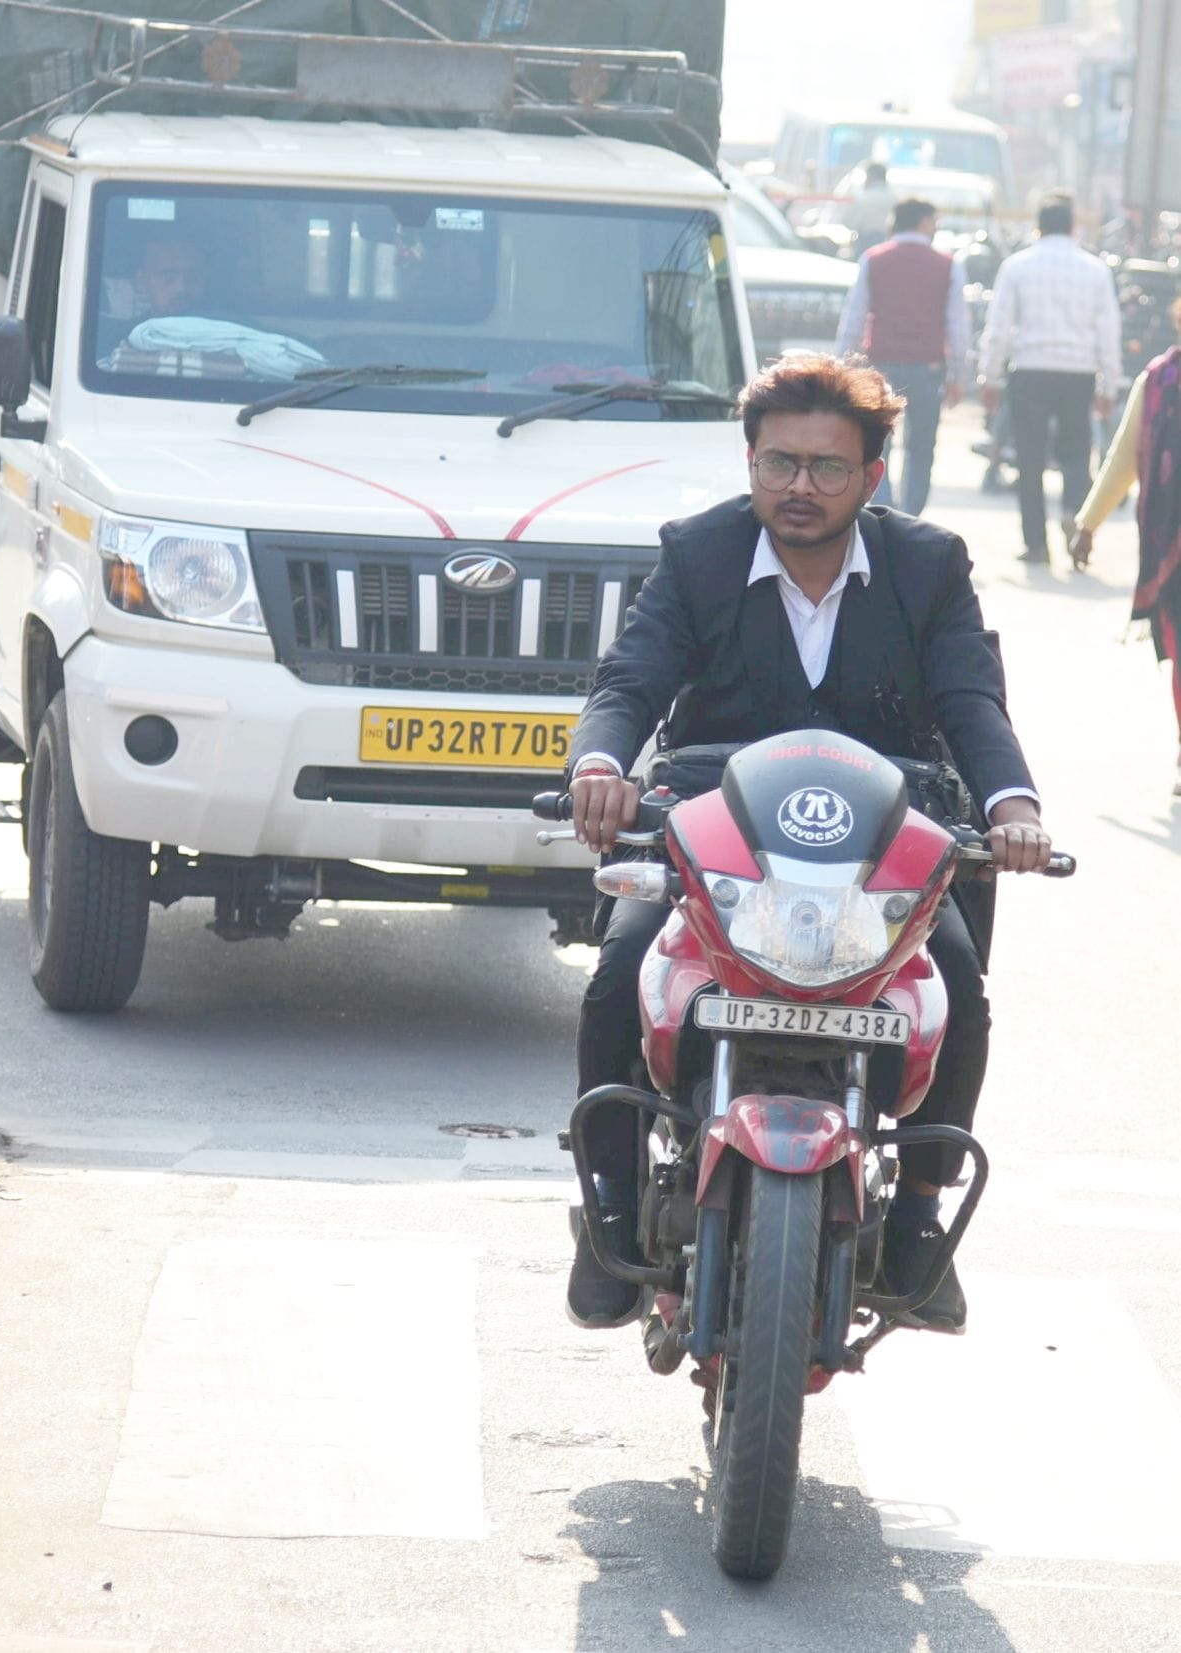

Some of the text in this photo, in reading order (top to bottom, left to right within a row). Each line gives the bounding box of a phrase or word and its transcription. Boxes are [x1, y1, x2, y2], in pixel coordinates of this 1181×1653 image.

[386, 717, 568, 757] UP32RT705
[767, 744, 874, 773] HIGH COURT
[781, 819, 848, 842] ADVOCATE
